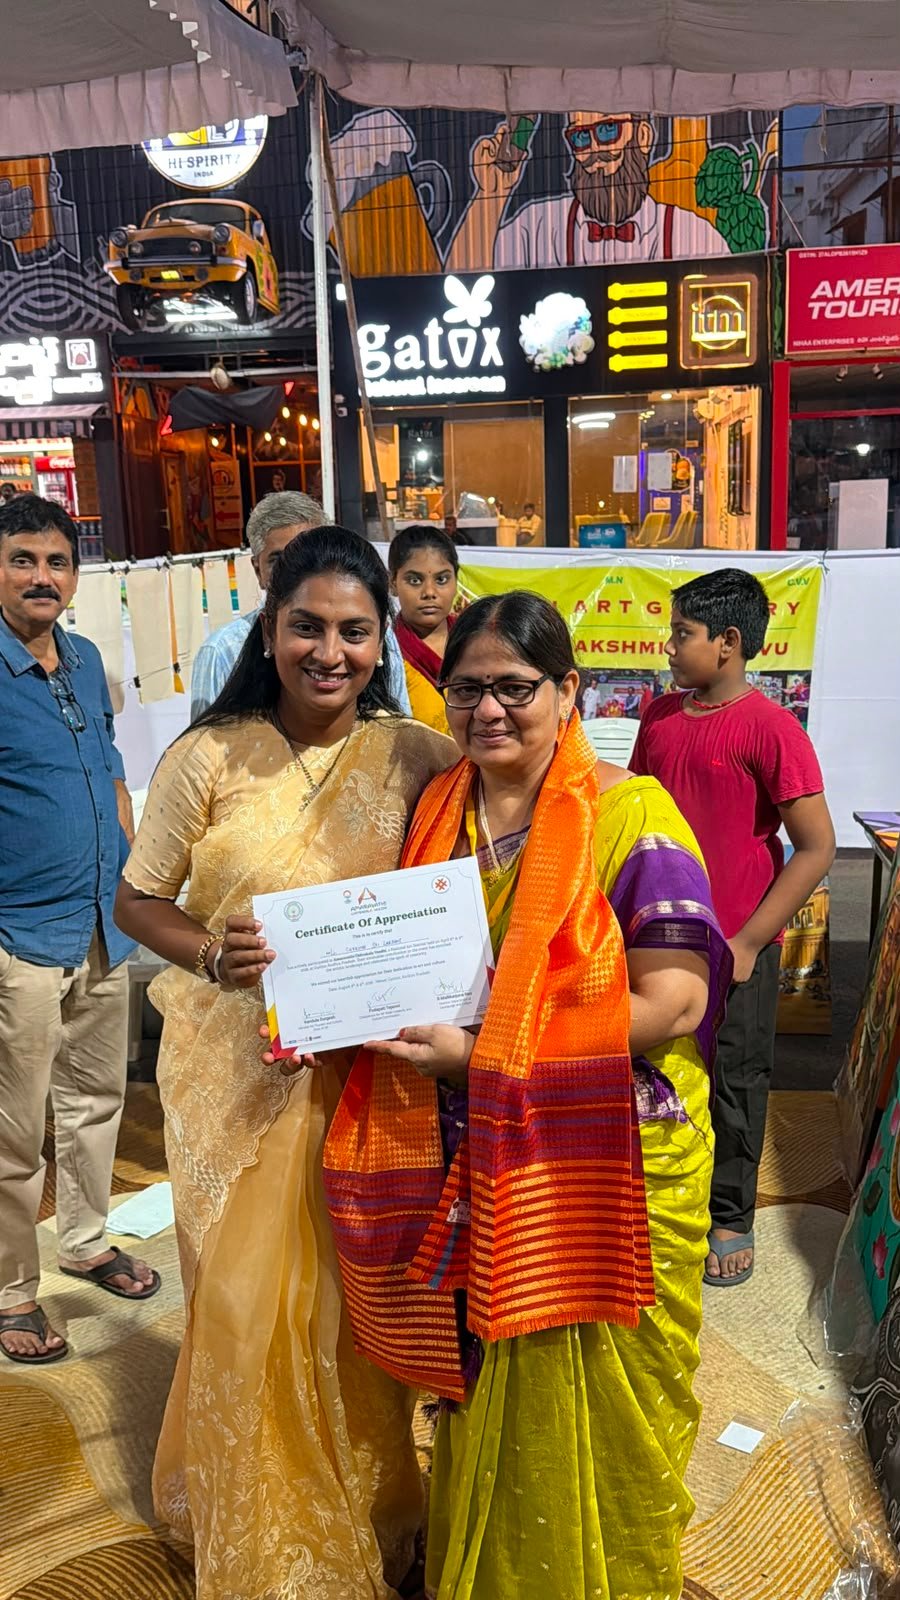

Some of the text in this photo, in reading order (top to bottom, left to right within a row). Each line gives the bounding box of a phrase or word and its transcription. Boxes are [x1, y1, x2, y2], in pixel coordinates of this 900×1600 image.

[168, 157, 182, 169] HI
[193, 170, 213, 178] INDIA
[808, 298, 900, 320] TOURI
[574, 599, 632, 614] ART
[574, 639, 663, 655] AKSHMI
[295, 922, 355, 939] Certificate
[358, 917, 372, 928] Of
[374, 906, 447, 926] Appreciation
